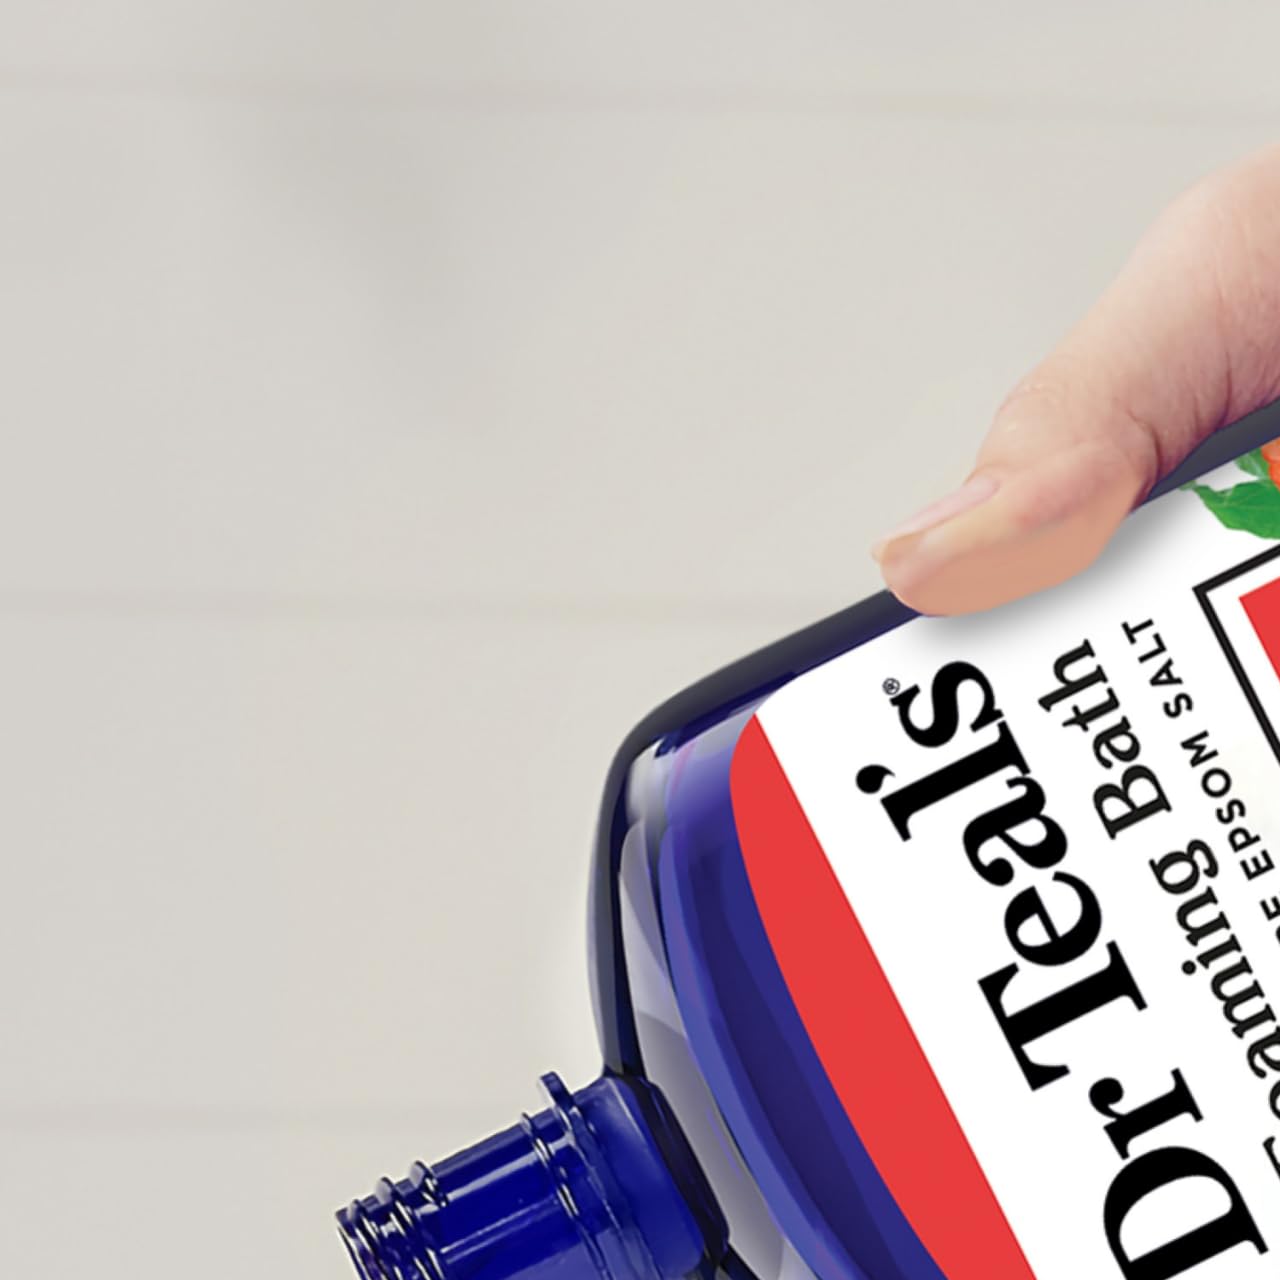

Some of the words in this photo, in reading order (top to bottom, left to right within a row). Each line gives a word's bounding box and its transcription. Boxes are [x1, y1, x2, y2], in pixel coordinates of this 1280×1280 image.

[1036, 638, 1173, 841] Bath
[1120, 618, 1194, 720] SALT
[854, 660, 1149, 1093] Teal's
[1179, 729, 1276, 882] EPSOM
